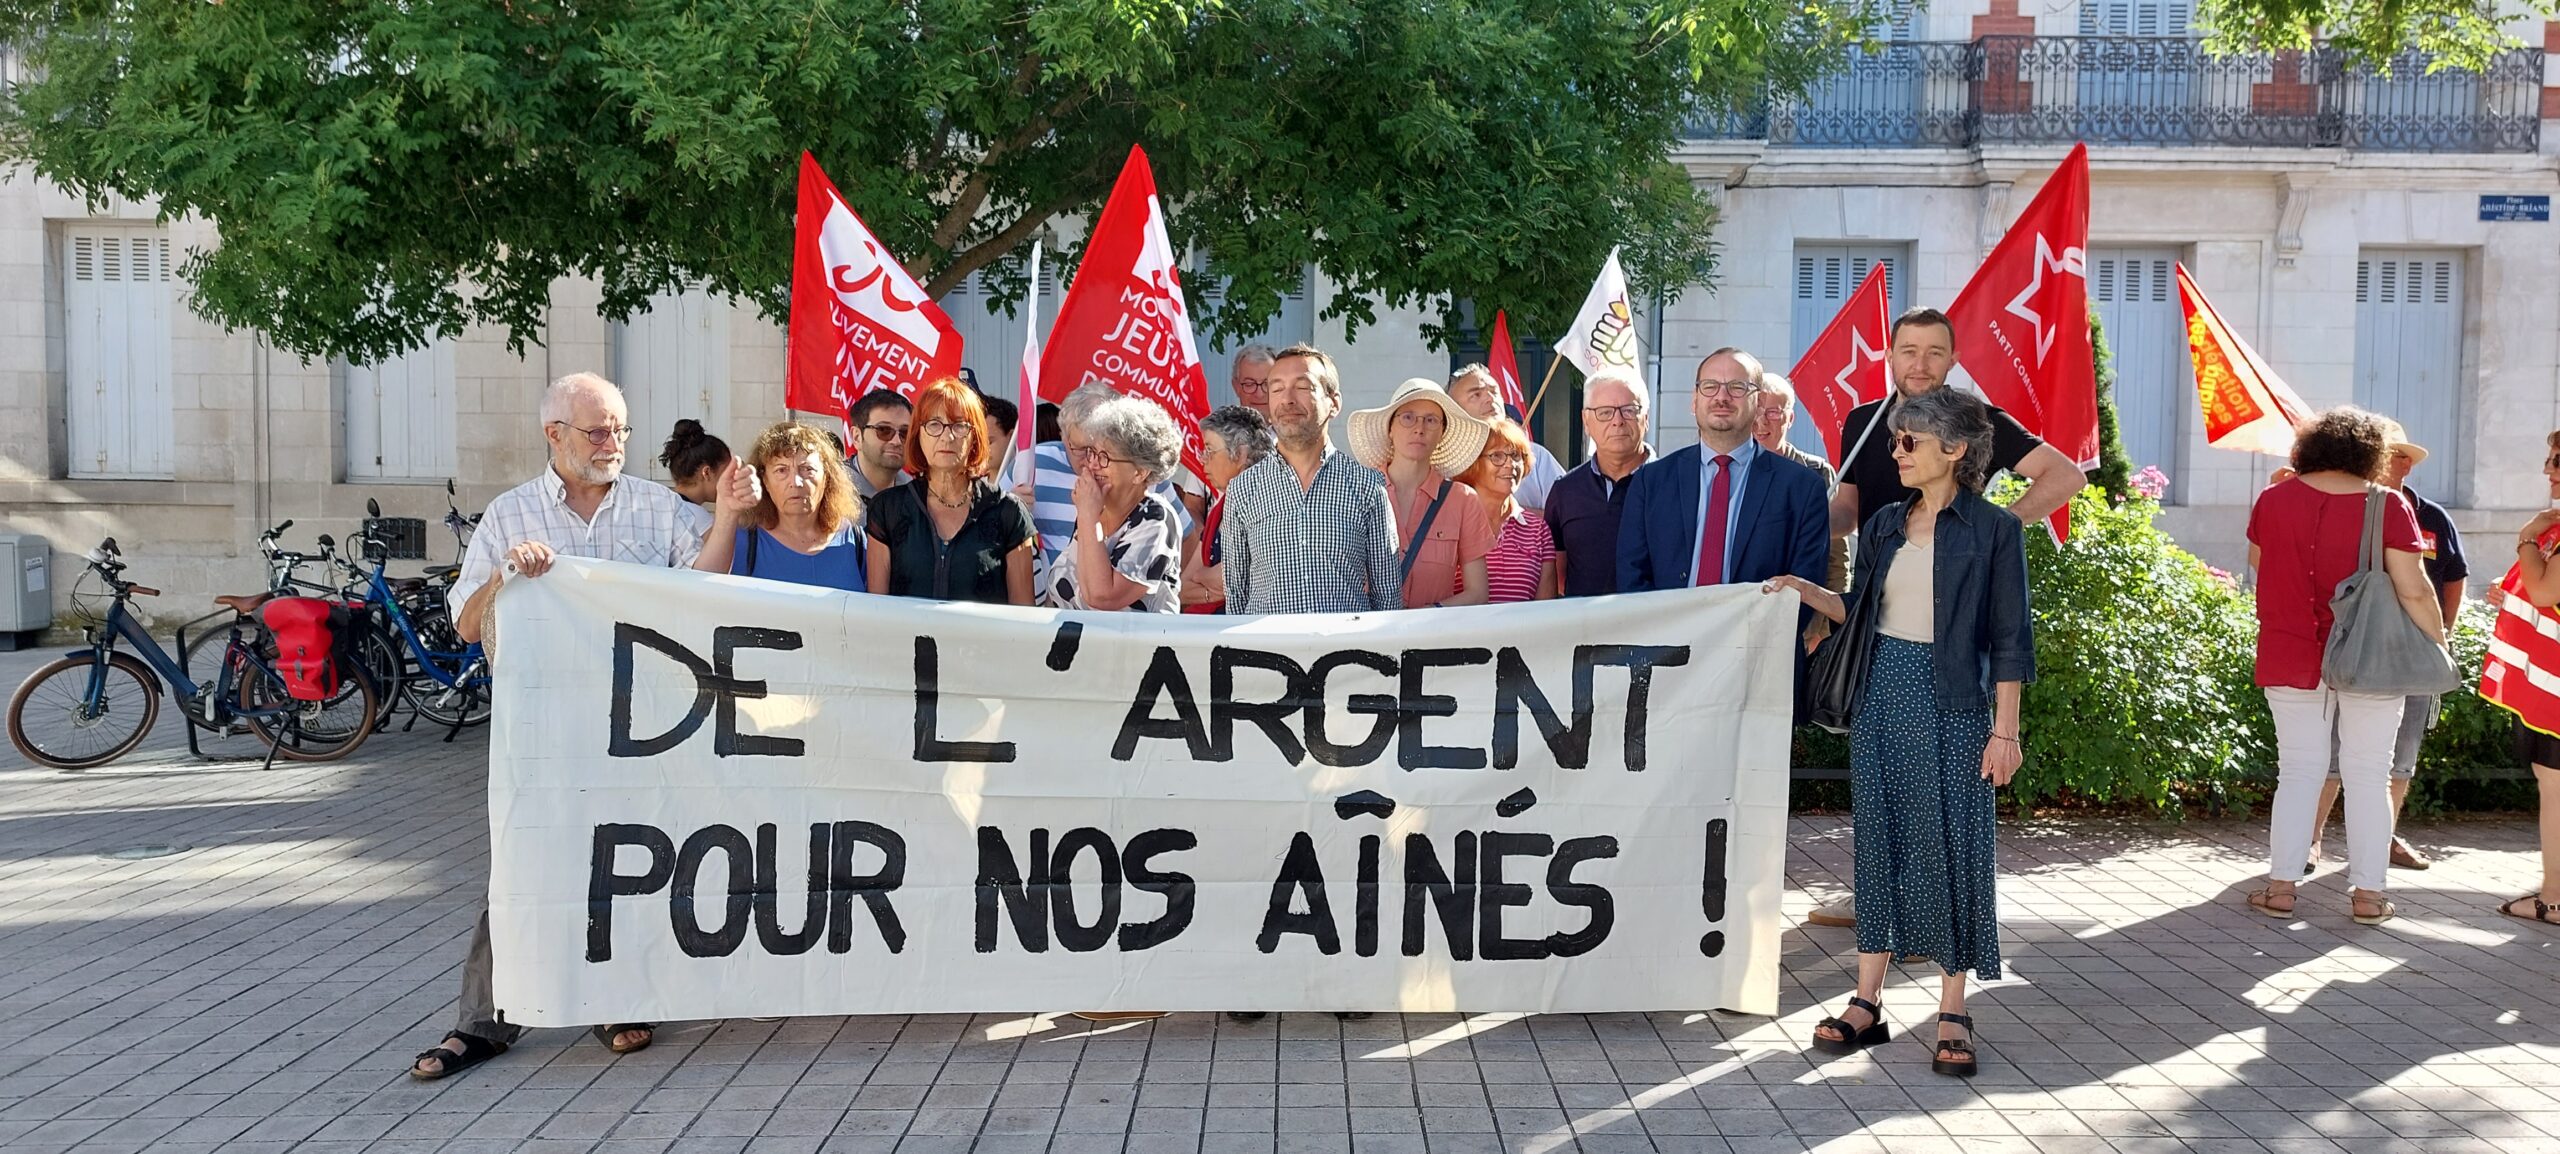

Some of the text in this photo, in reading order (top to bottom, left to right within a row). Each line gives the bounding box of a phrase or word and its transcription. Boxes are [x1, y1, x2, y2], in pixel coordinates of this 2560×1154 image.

[829, 299, 931, 381] UVEMENT
[1988, 320, 2014, 357] PARTI
[1823, 385, 1838, 418] PARTI
[608, 621, 805, 759] DE
[586, 787, 1728, 964] POUR NOS AÎNÉS !
